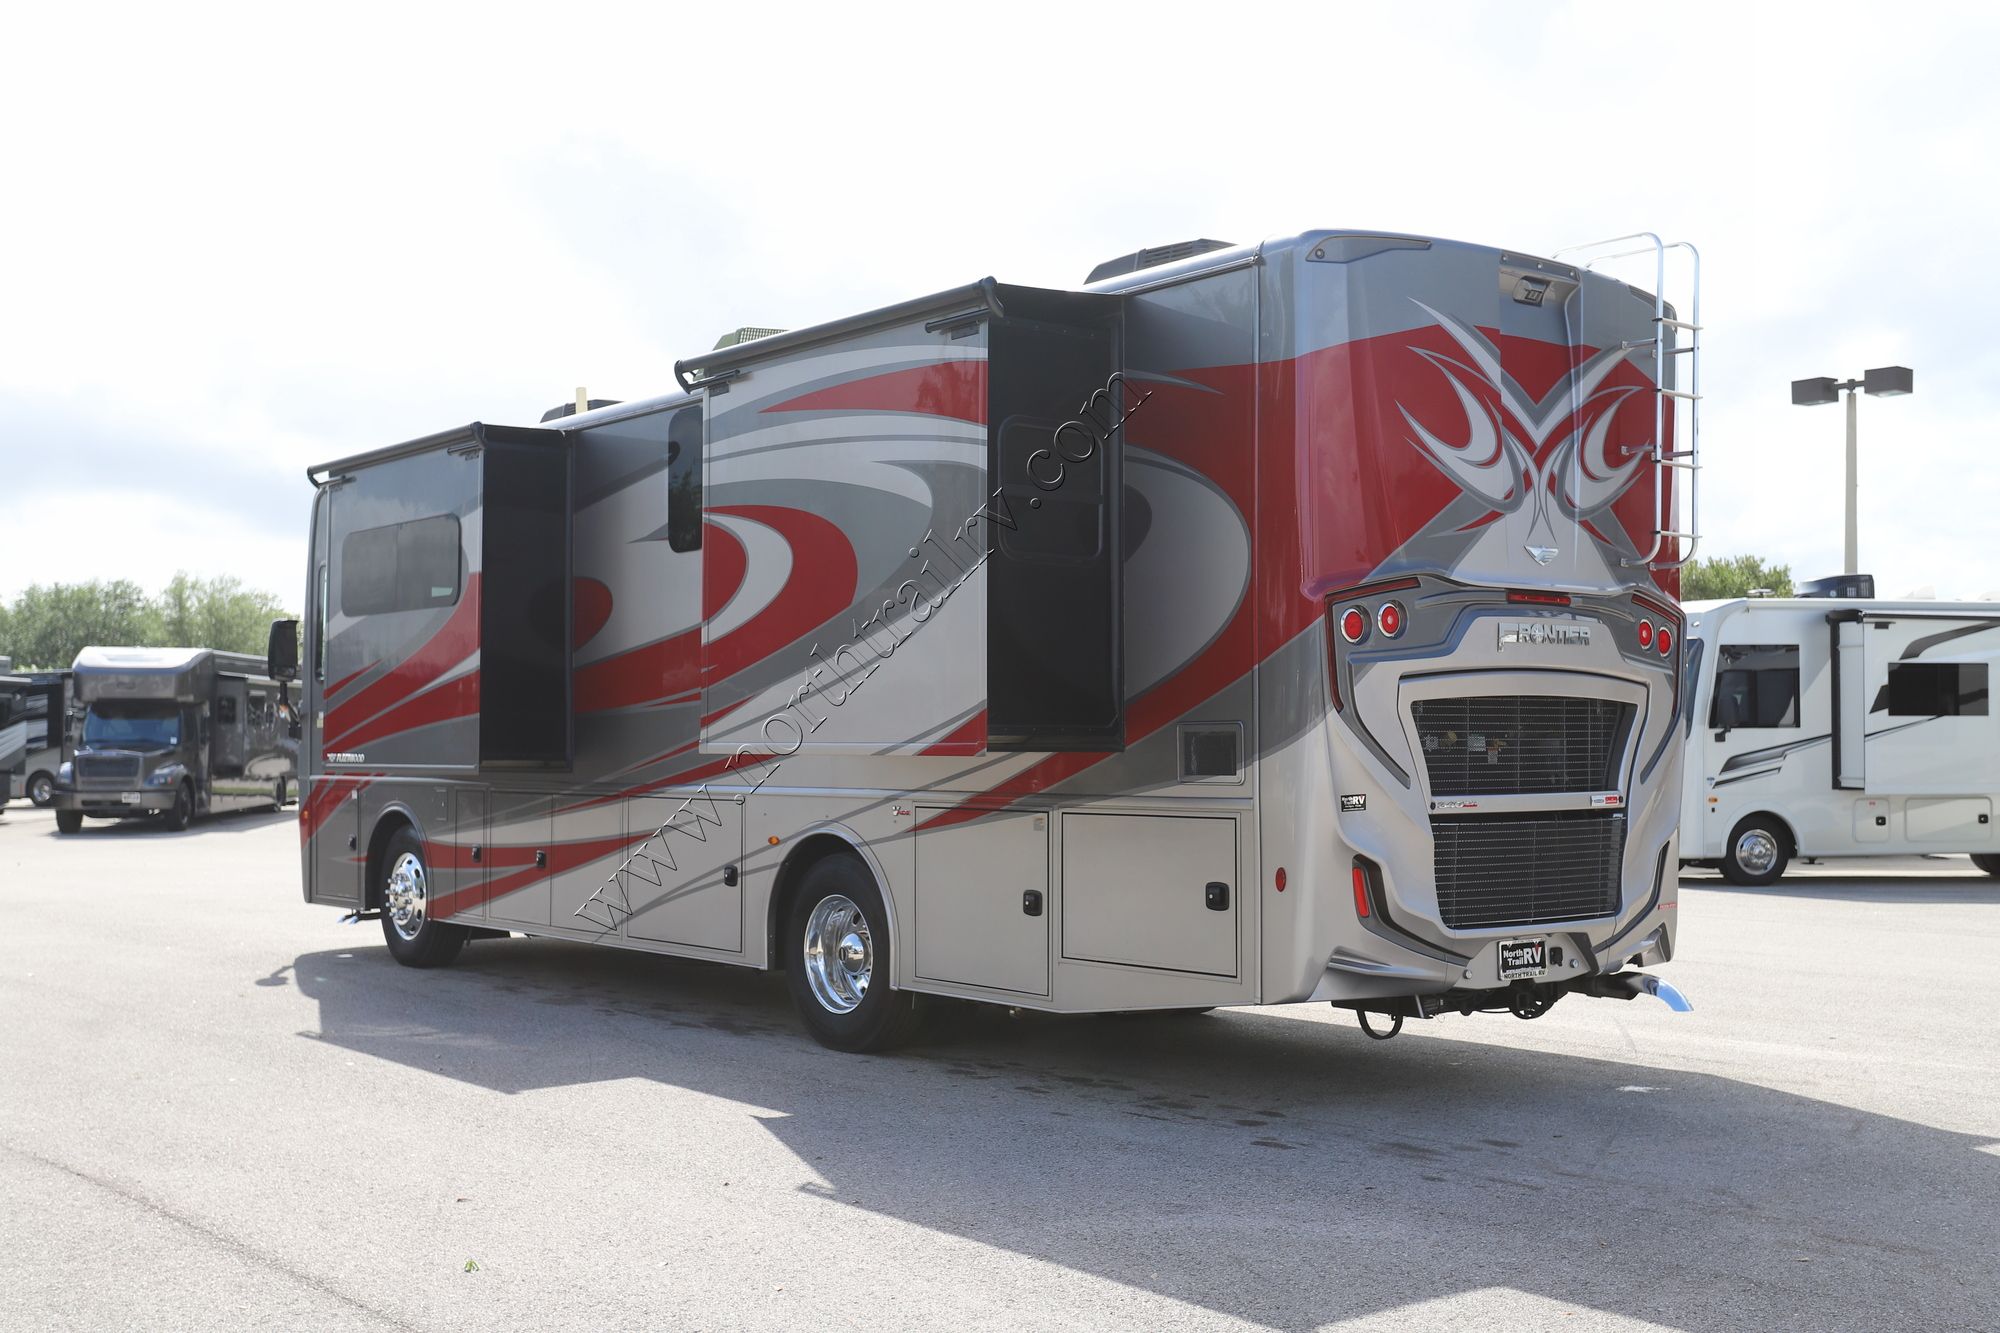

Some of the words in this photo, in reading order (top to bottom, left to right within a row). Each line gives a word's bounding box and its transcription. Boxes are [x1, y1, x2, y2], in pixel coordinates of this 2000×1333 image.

[1497, 622, 1591, 652] FRONTIER
[1352, 795, 1365, 805] RV
[1503, 948, 1523, 958] North
[1523, 946, 1542, 964] RV
[1507, 957, 1524, 966] Trail
[1523, 970, 1537, 978] TRAIL
